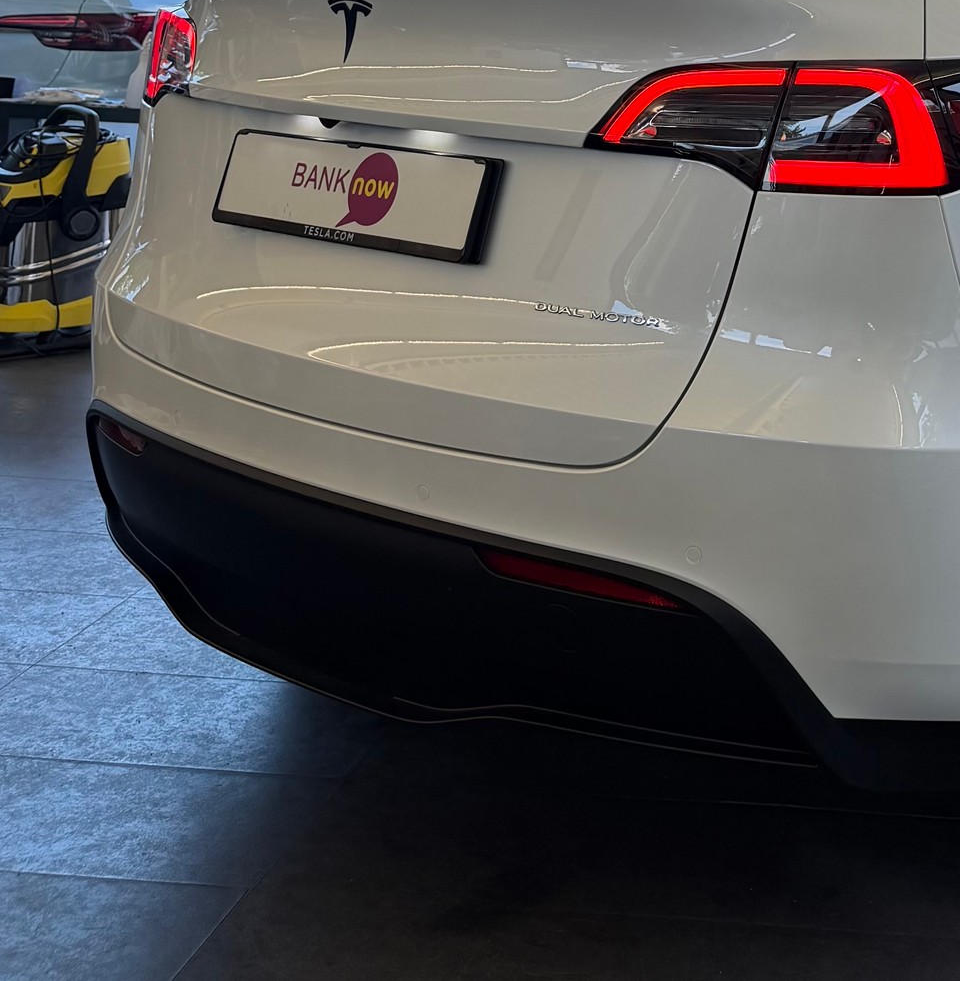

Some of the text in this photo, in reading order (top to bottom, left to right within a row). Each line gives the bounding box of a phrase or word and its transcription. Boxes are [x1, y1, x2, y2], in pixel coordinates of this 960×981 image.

[292, 162, 394, 200] BANK now
[303, 225, 355, 242] TESLA.COM
[534, 302, 660, 328] DUAL MOTOR
